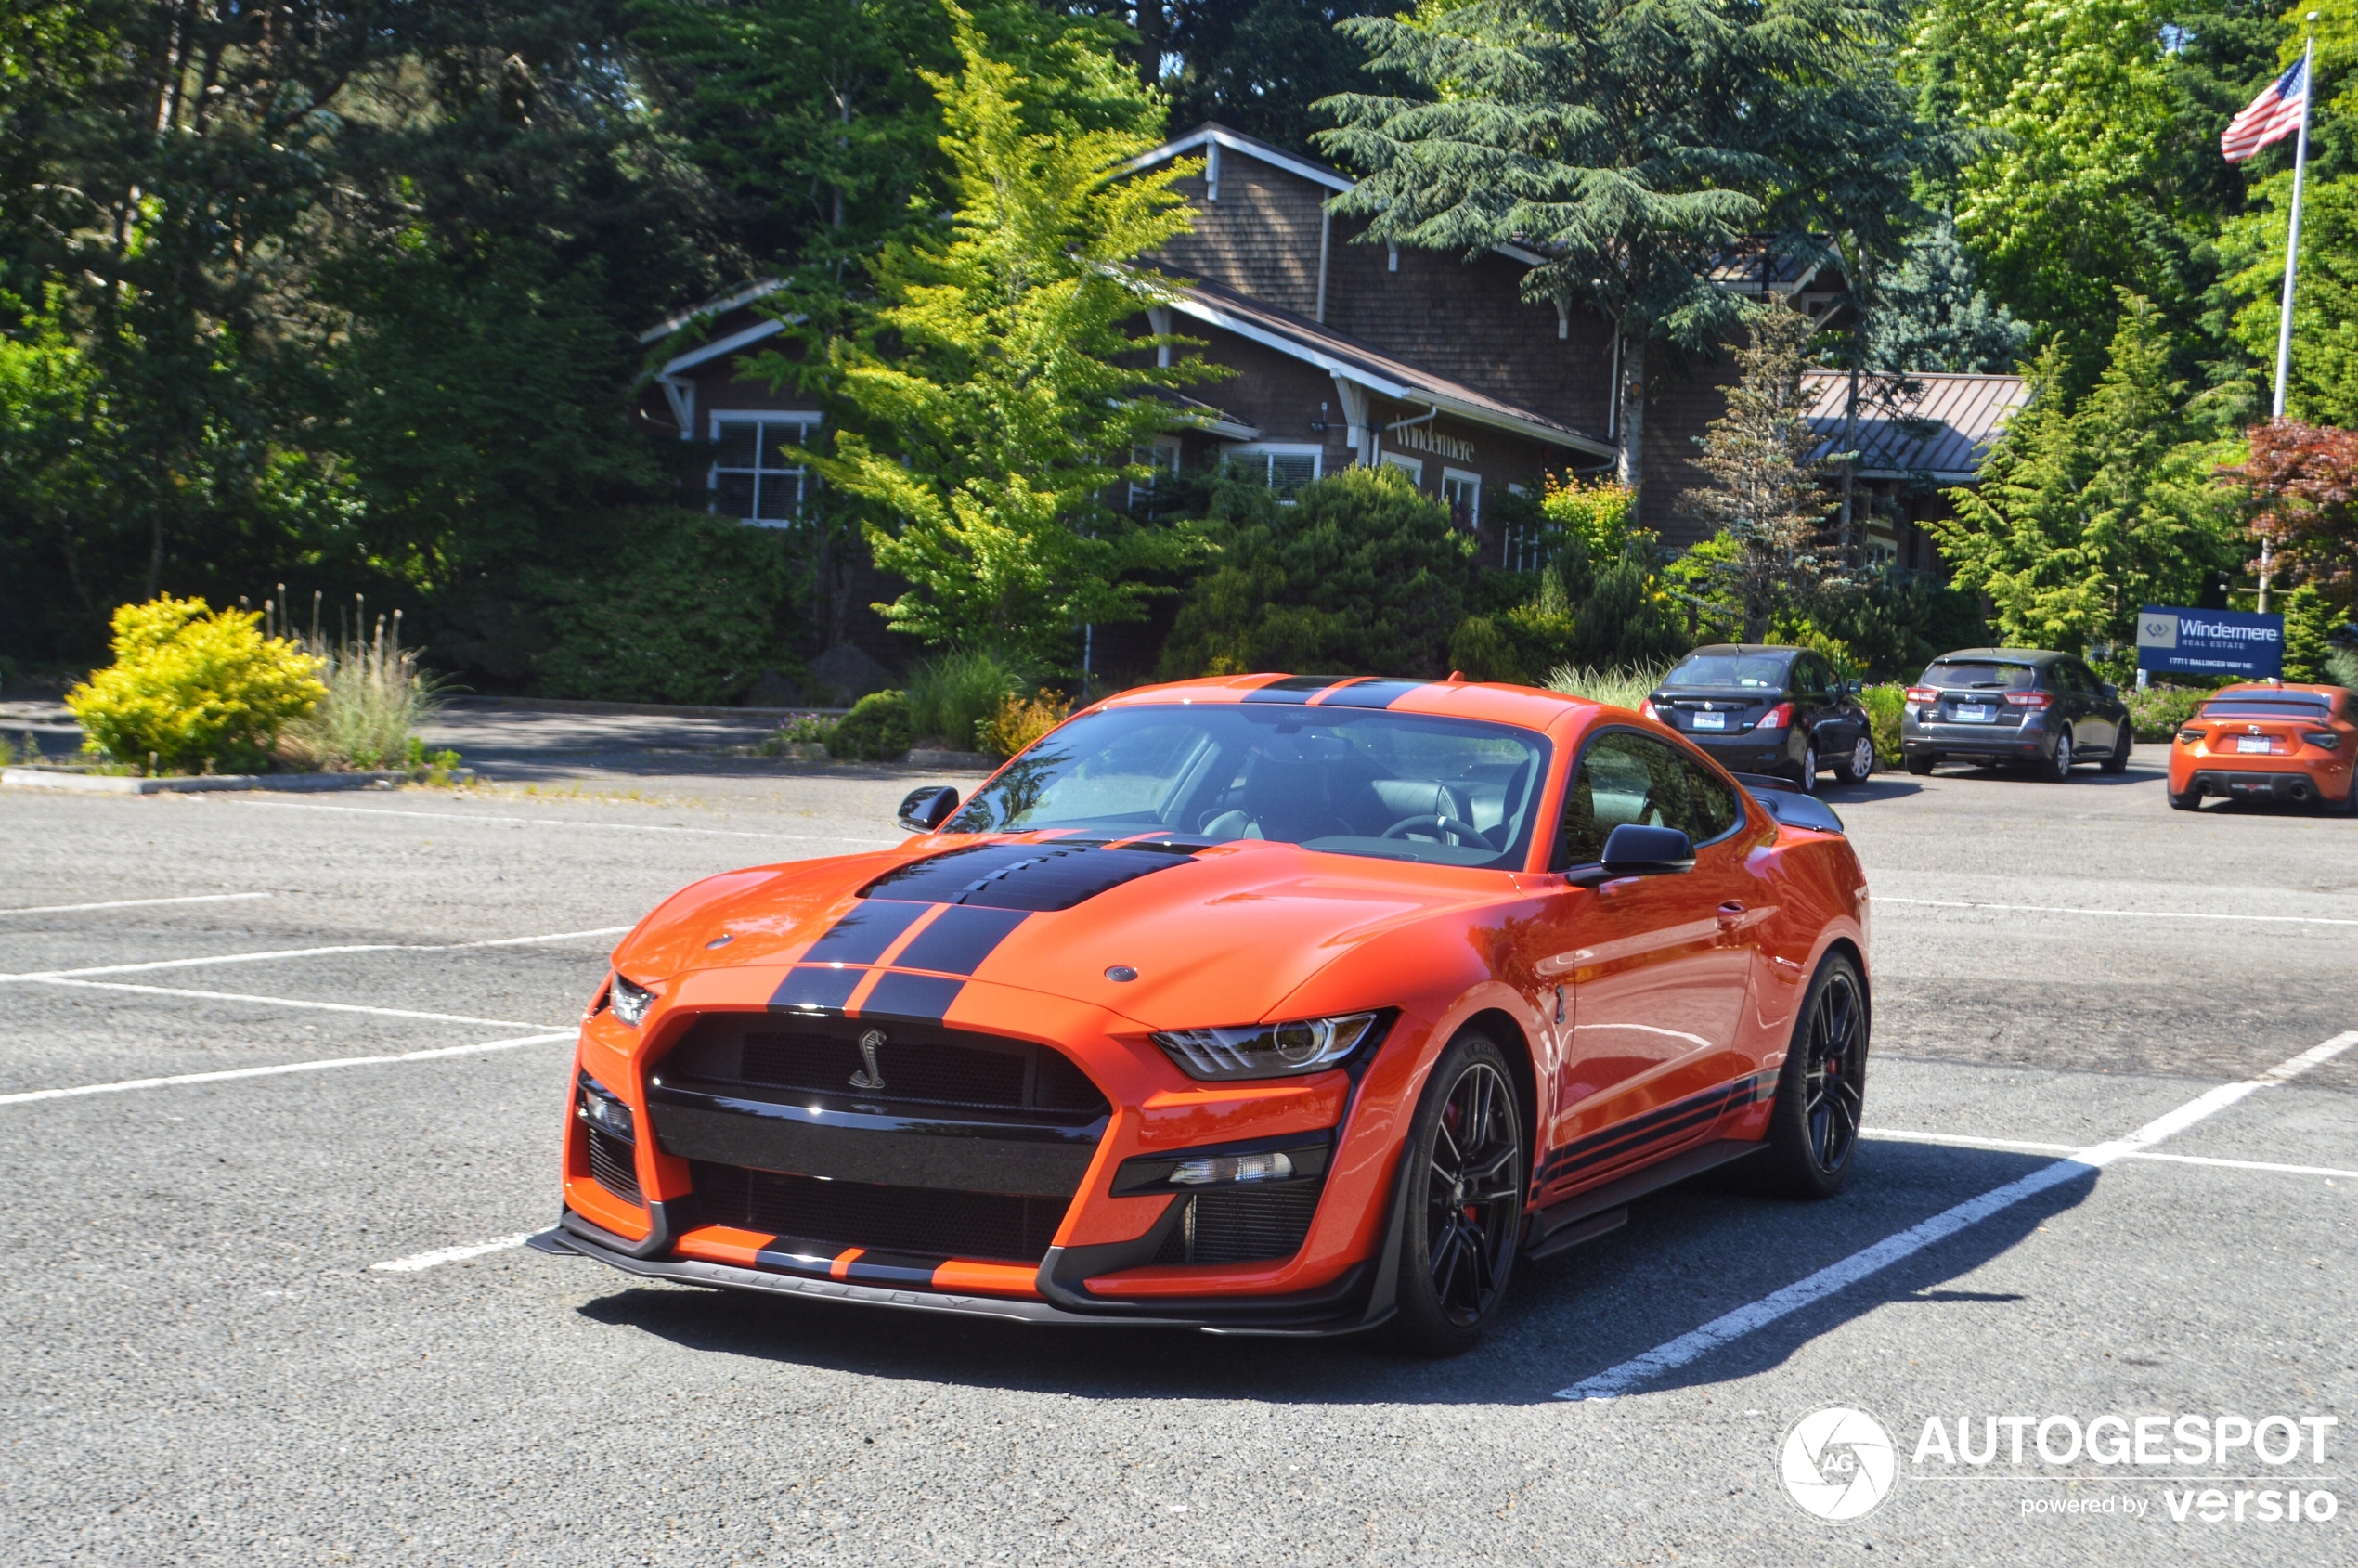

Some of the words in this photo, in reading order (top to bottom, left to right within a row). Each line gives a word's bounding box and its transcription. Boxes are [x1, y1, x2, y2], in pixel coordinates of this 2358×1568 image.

[2180, 618, 2279, 641] Windermere
[2182, 639, 2206, 648] REAL
[2210, 641, 2245, 650] ESTATE
[2226, 660, 2242, 669] WAY
[709, 1268, 976, 1307] SHELBY
